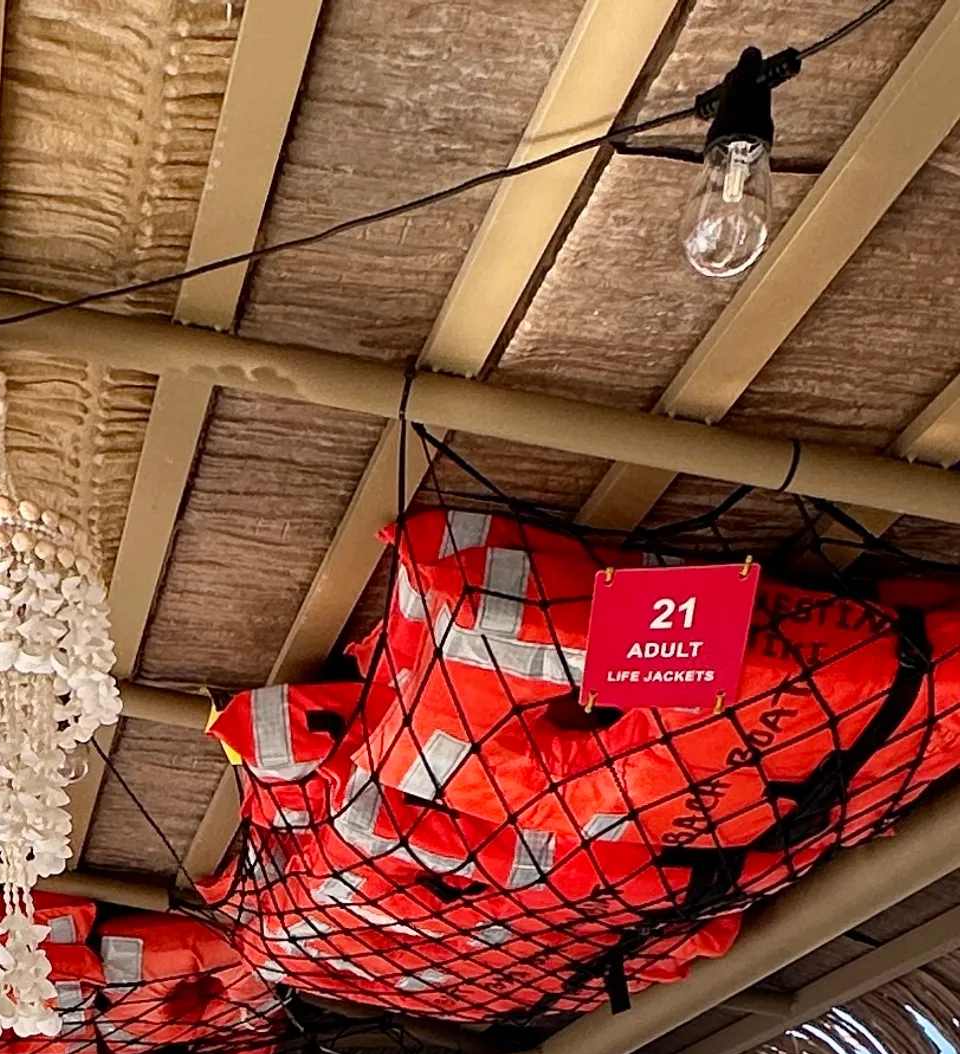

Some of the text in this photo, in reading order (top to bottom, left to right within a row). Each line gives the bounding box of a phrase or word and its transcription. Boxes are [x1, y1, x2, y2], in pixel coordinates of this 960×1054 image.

[649, 596, 697, 630] 21
[626, 641, 704, 659] ADULT
[606, 669, 715, 683] LIFE JACKETS
